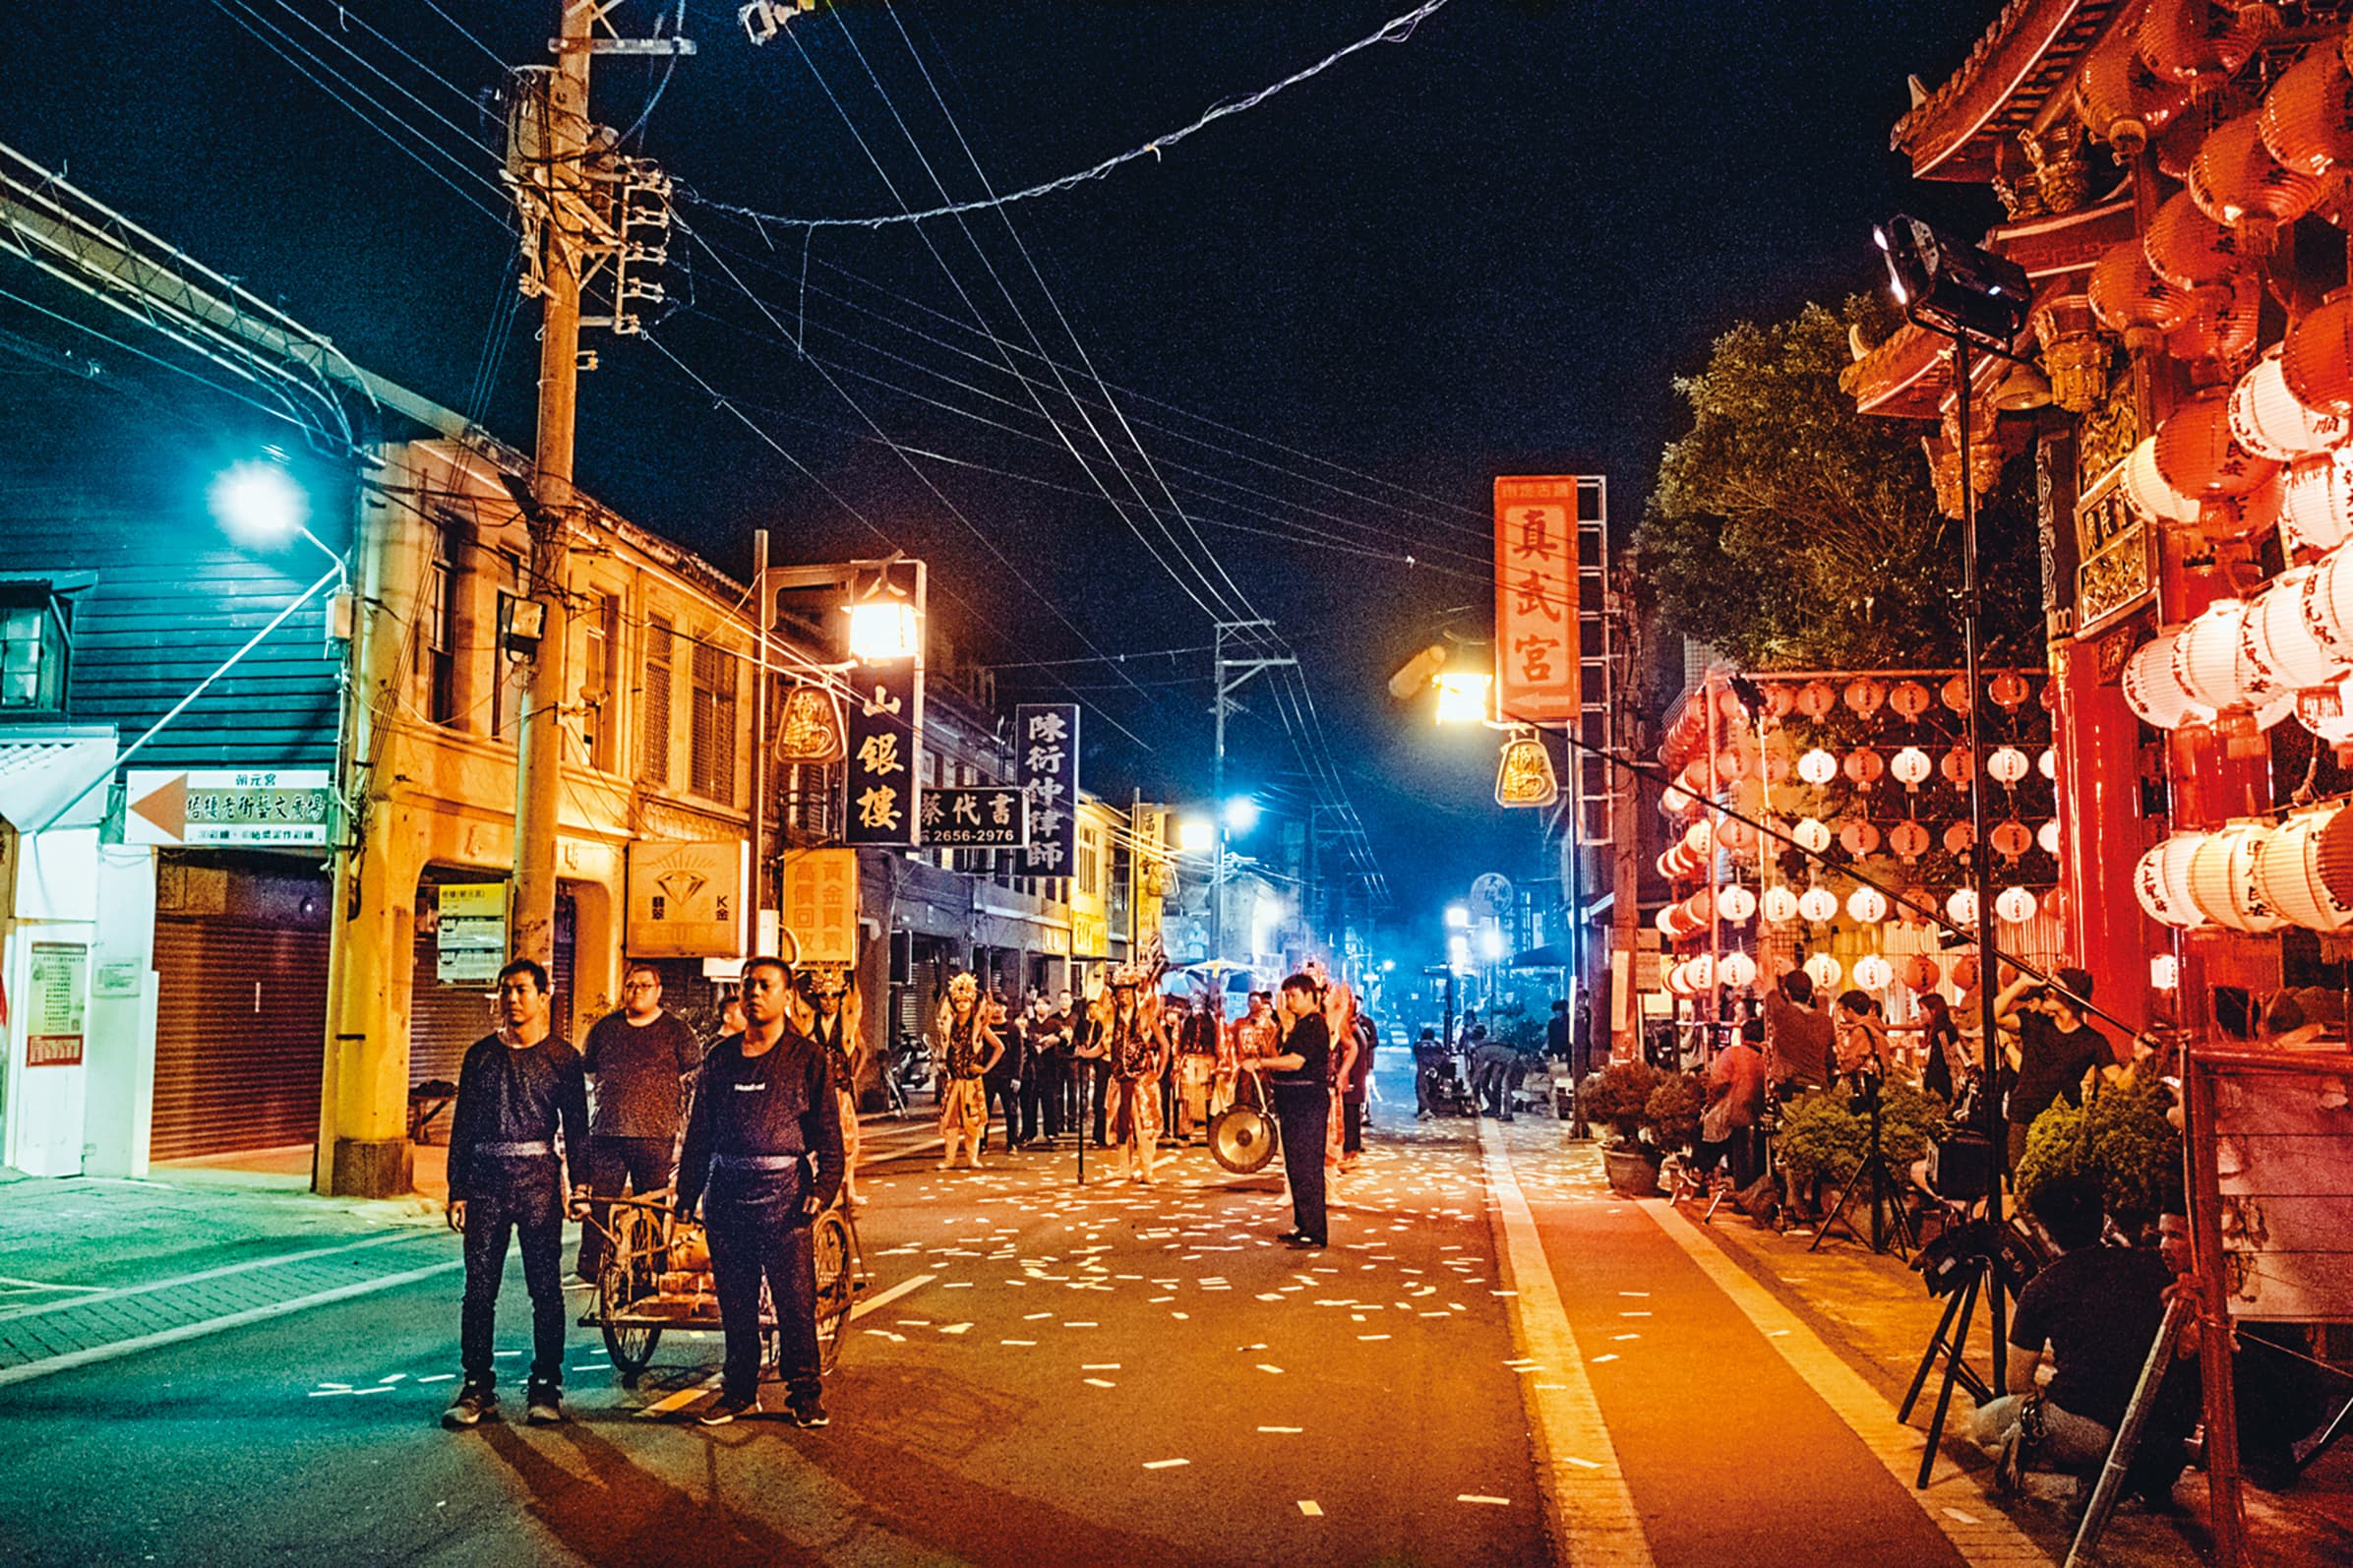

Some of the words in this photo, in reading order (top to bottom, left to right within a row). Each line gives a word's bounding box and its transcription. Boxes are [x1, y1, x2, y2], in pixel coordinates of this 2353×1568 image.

[1513, 509, 1561, 682] 真武宮
[856, 685, 905, 831] 山銀樓
[1025, 712, 1068, 871] 陳衍仲律師
[934, 828, 1015, 842] 2656-2976
